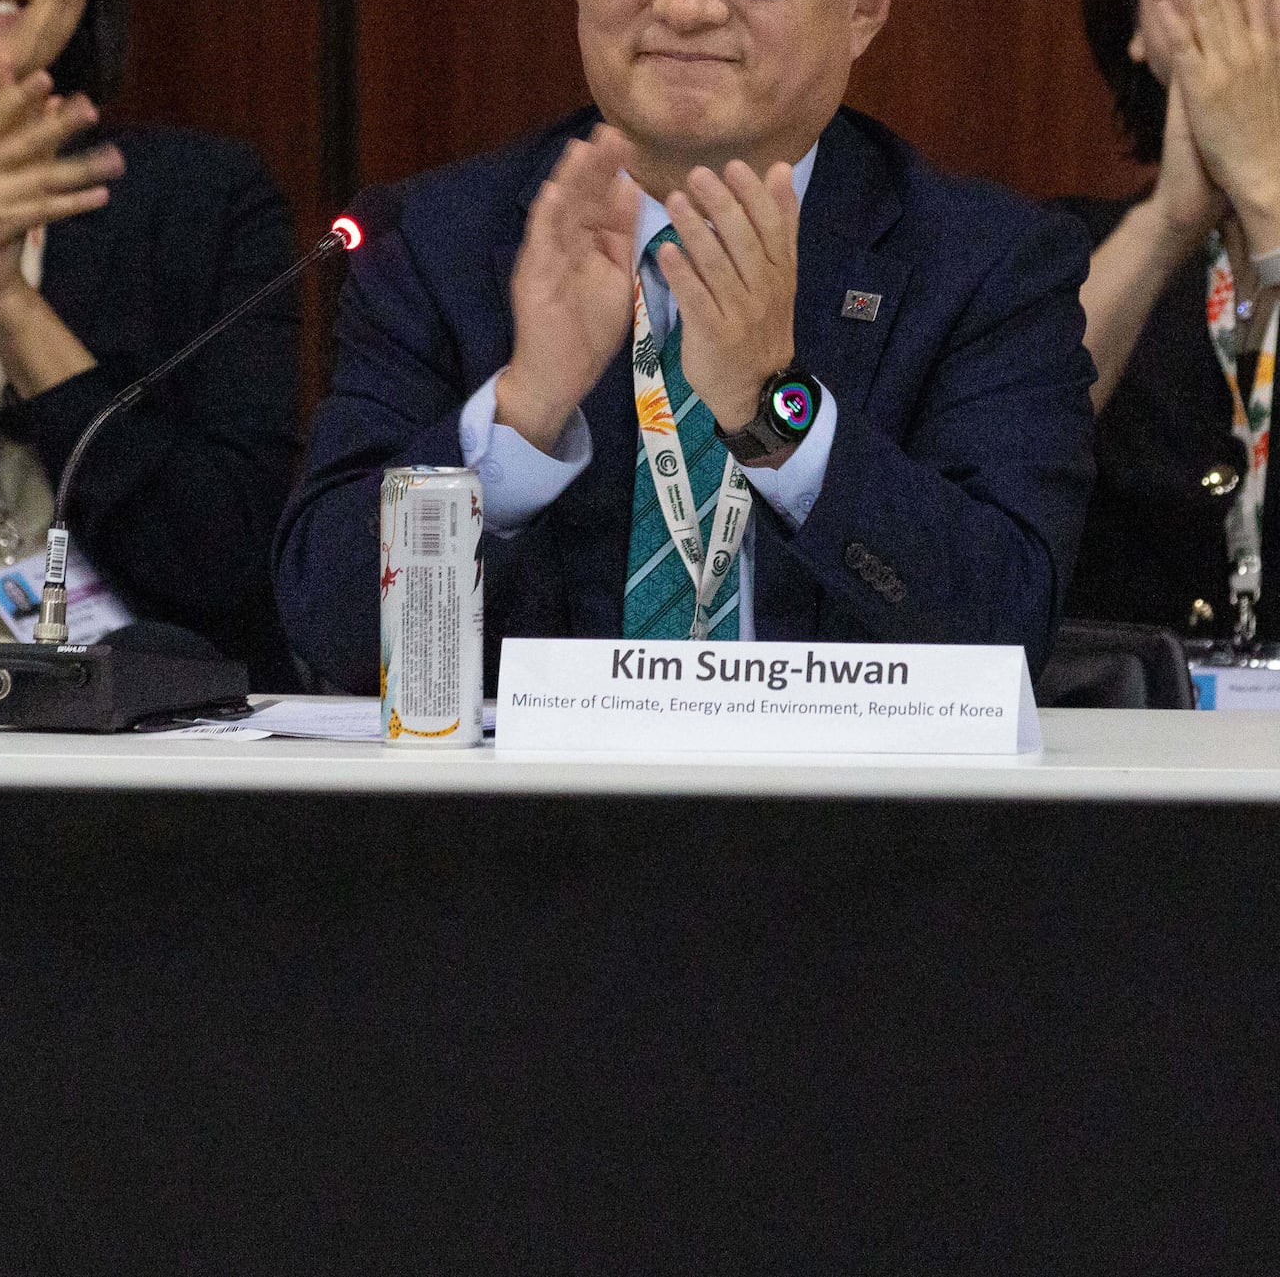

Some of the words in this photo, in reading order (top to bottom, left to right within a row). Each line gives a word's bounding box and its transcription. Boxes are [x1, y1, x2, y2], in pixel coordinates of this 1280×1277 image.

[611, 648, 683, 681] Kim
[695, 650, 909, 691] Sung-hwan
[511, 692, 577, 709] Minister
[580, 694, 597, 709] of
[601, 695, 665, 713] Climate,
[669, 697, 723, 716] Energy
[726, 699, 756, 714] and
[760, 699, 864, 717] Environment,
[868, 701, 935, 718] Republic
[938, 702, 955, 716] of
[959, 703, 1004, 717] Korea
